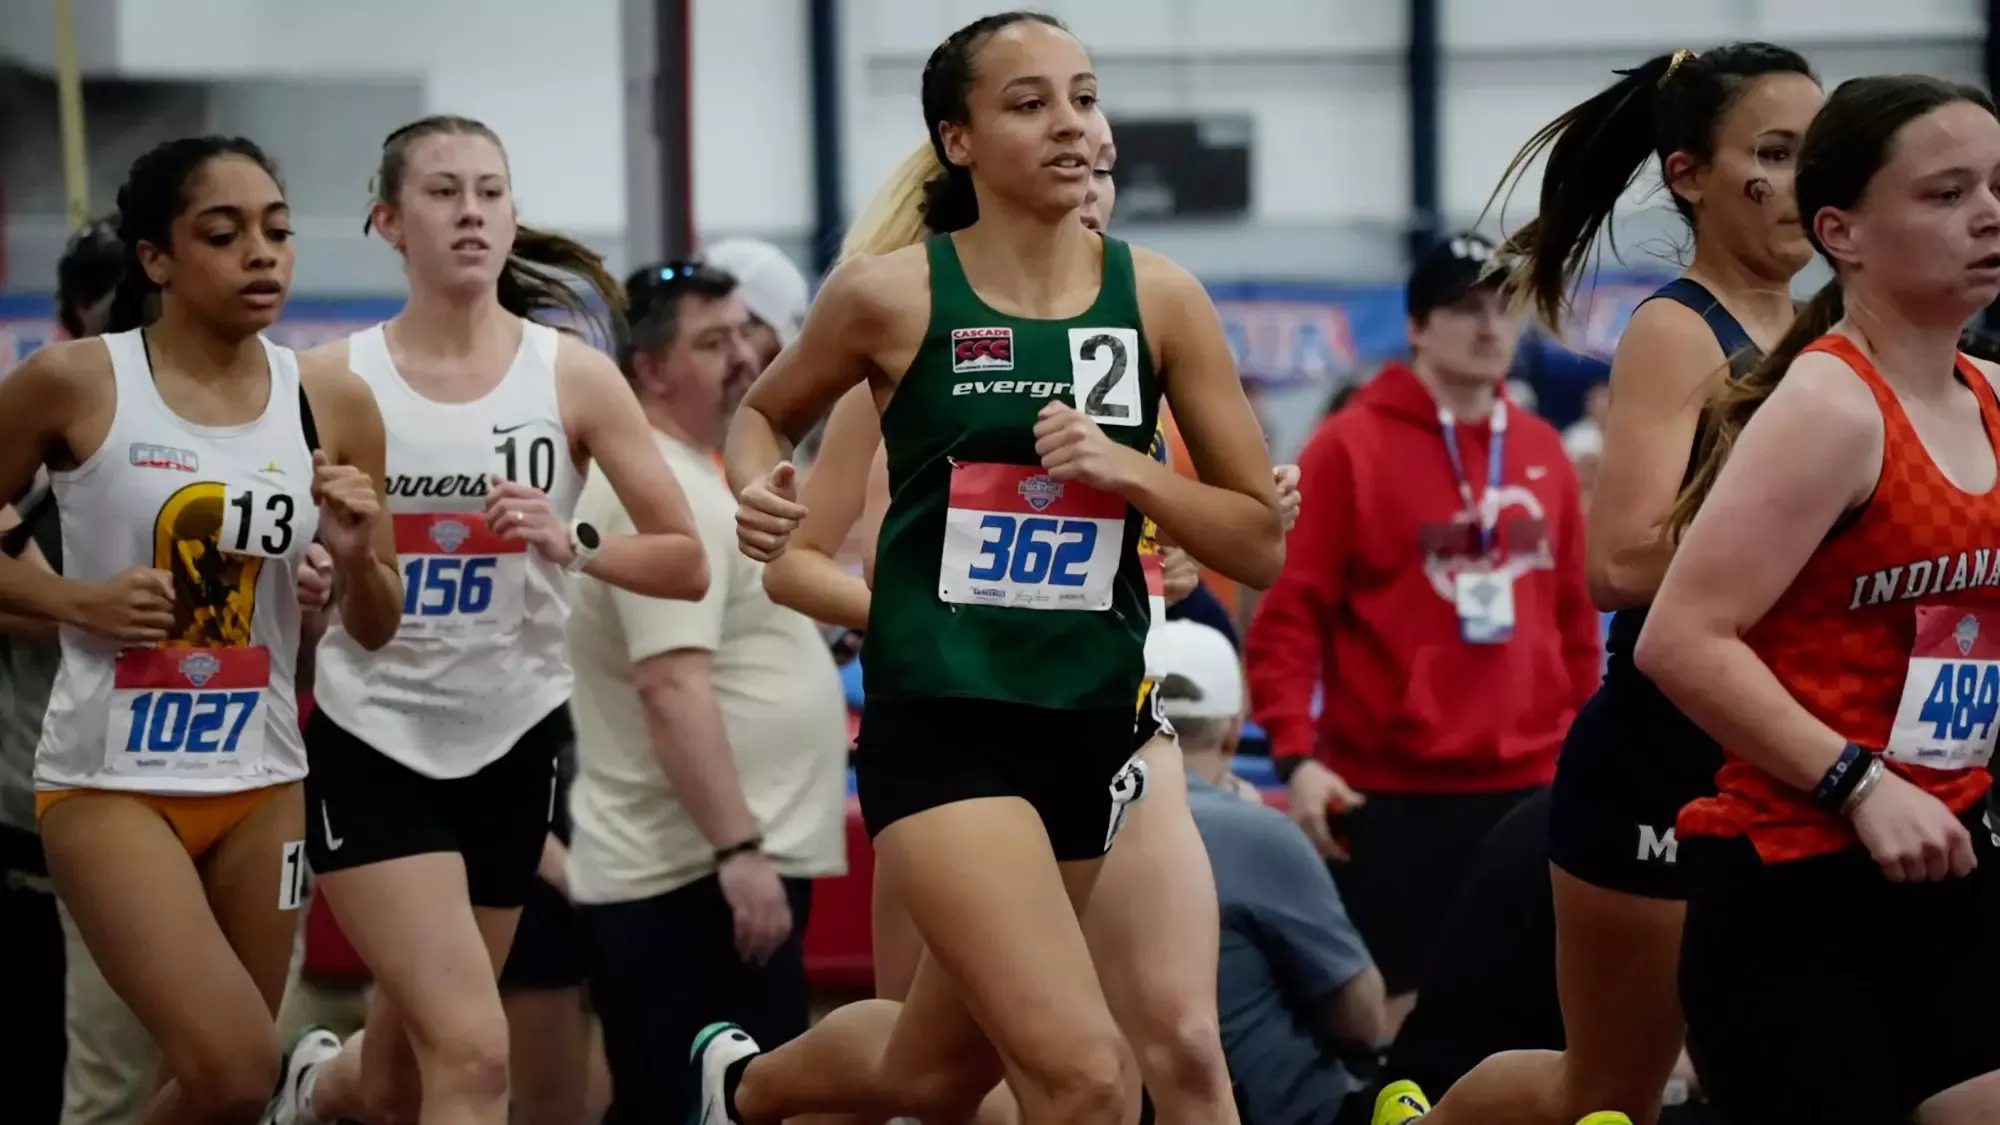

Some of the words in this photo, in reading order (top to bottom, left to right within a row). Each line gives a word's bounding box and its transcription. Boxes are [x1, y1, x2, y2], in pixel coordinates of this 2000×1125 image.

[953, 329, 1010, 339] CASCADE
[956, 340, 1009, 358] CCC
[952, 380, 1075, 398] evergr
[1080, 334, 1129, 418] 2
[495, 436, 555, 496] 10
[231, 491, 294, 555] 13
[968, 515, 1098, 587] 362
[402, 557, 499, 617] 156
[125, 691, 260, 753] 1027
[1918, 664, 2000, 741] 484
[1636, 824, 1678, 862] M
